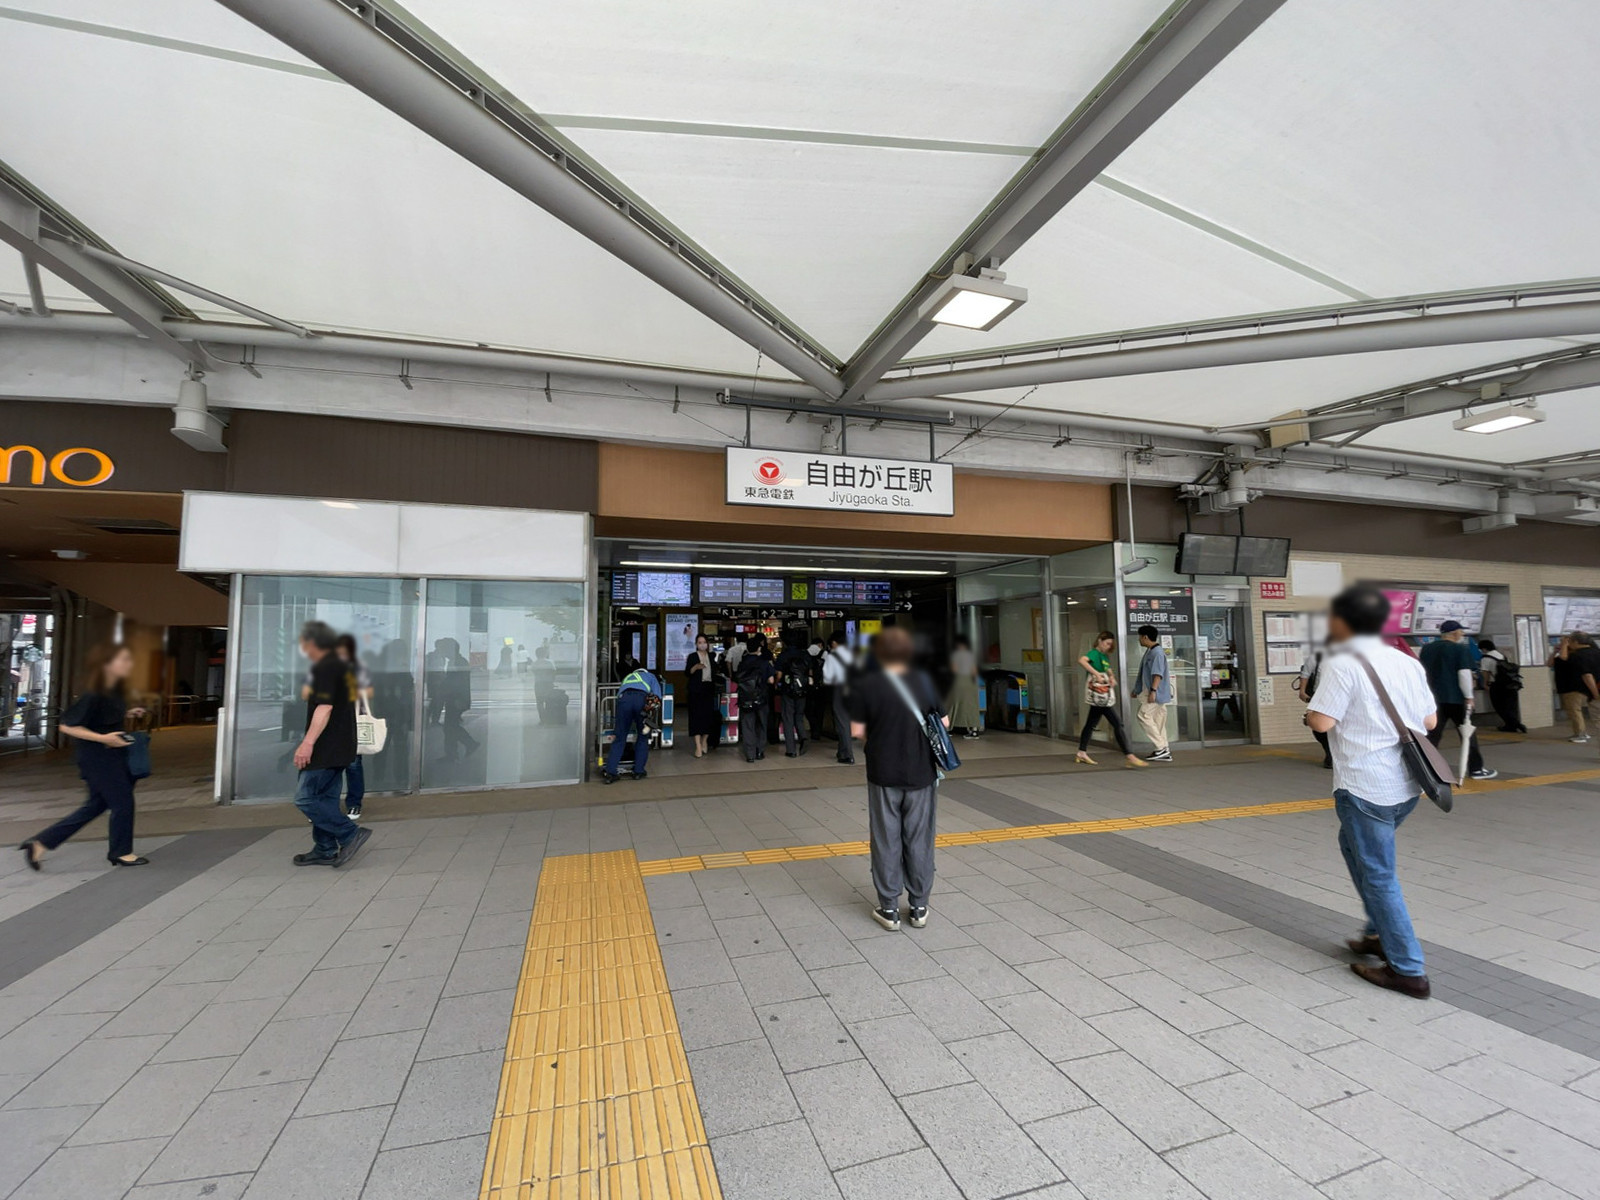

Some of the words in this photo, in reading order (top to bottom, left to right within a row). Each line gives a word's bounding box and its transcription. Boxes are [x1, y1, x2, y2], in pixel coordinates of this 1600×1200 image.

[807, 460, 933, 493] 自由が丘駅
[744, 486, 795, 501] 東急電鉄
[829, 492, 888, 507] Jiyūgaoka
[891, 495, 914, 507] Sta.
[1130, 612, 1168, 622] 自由が丘駅
